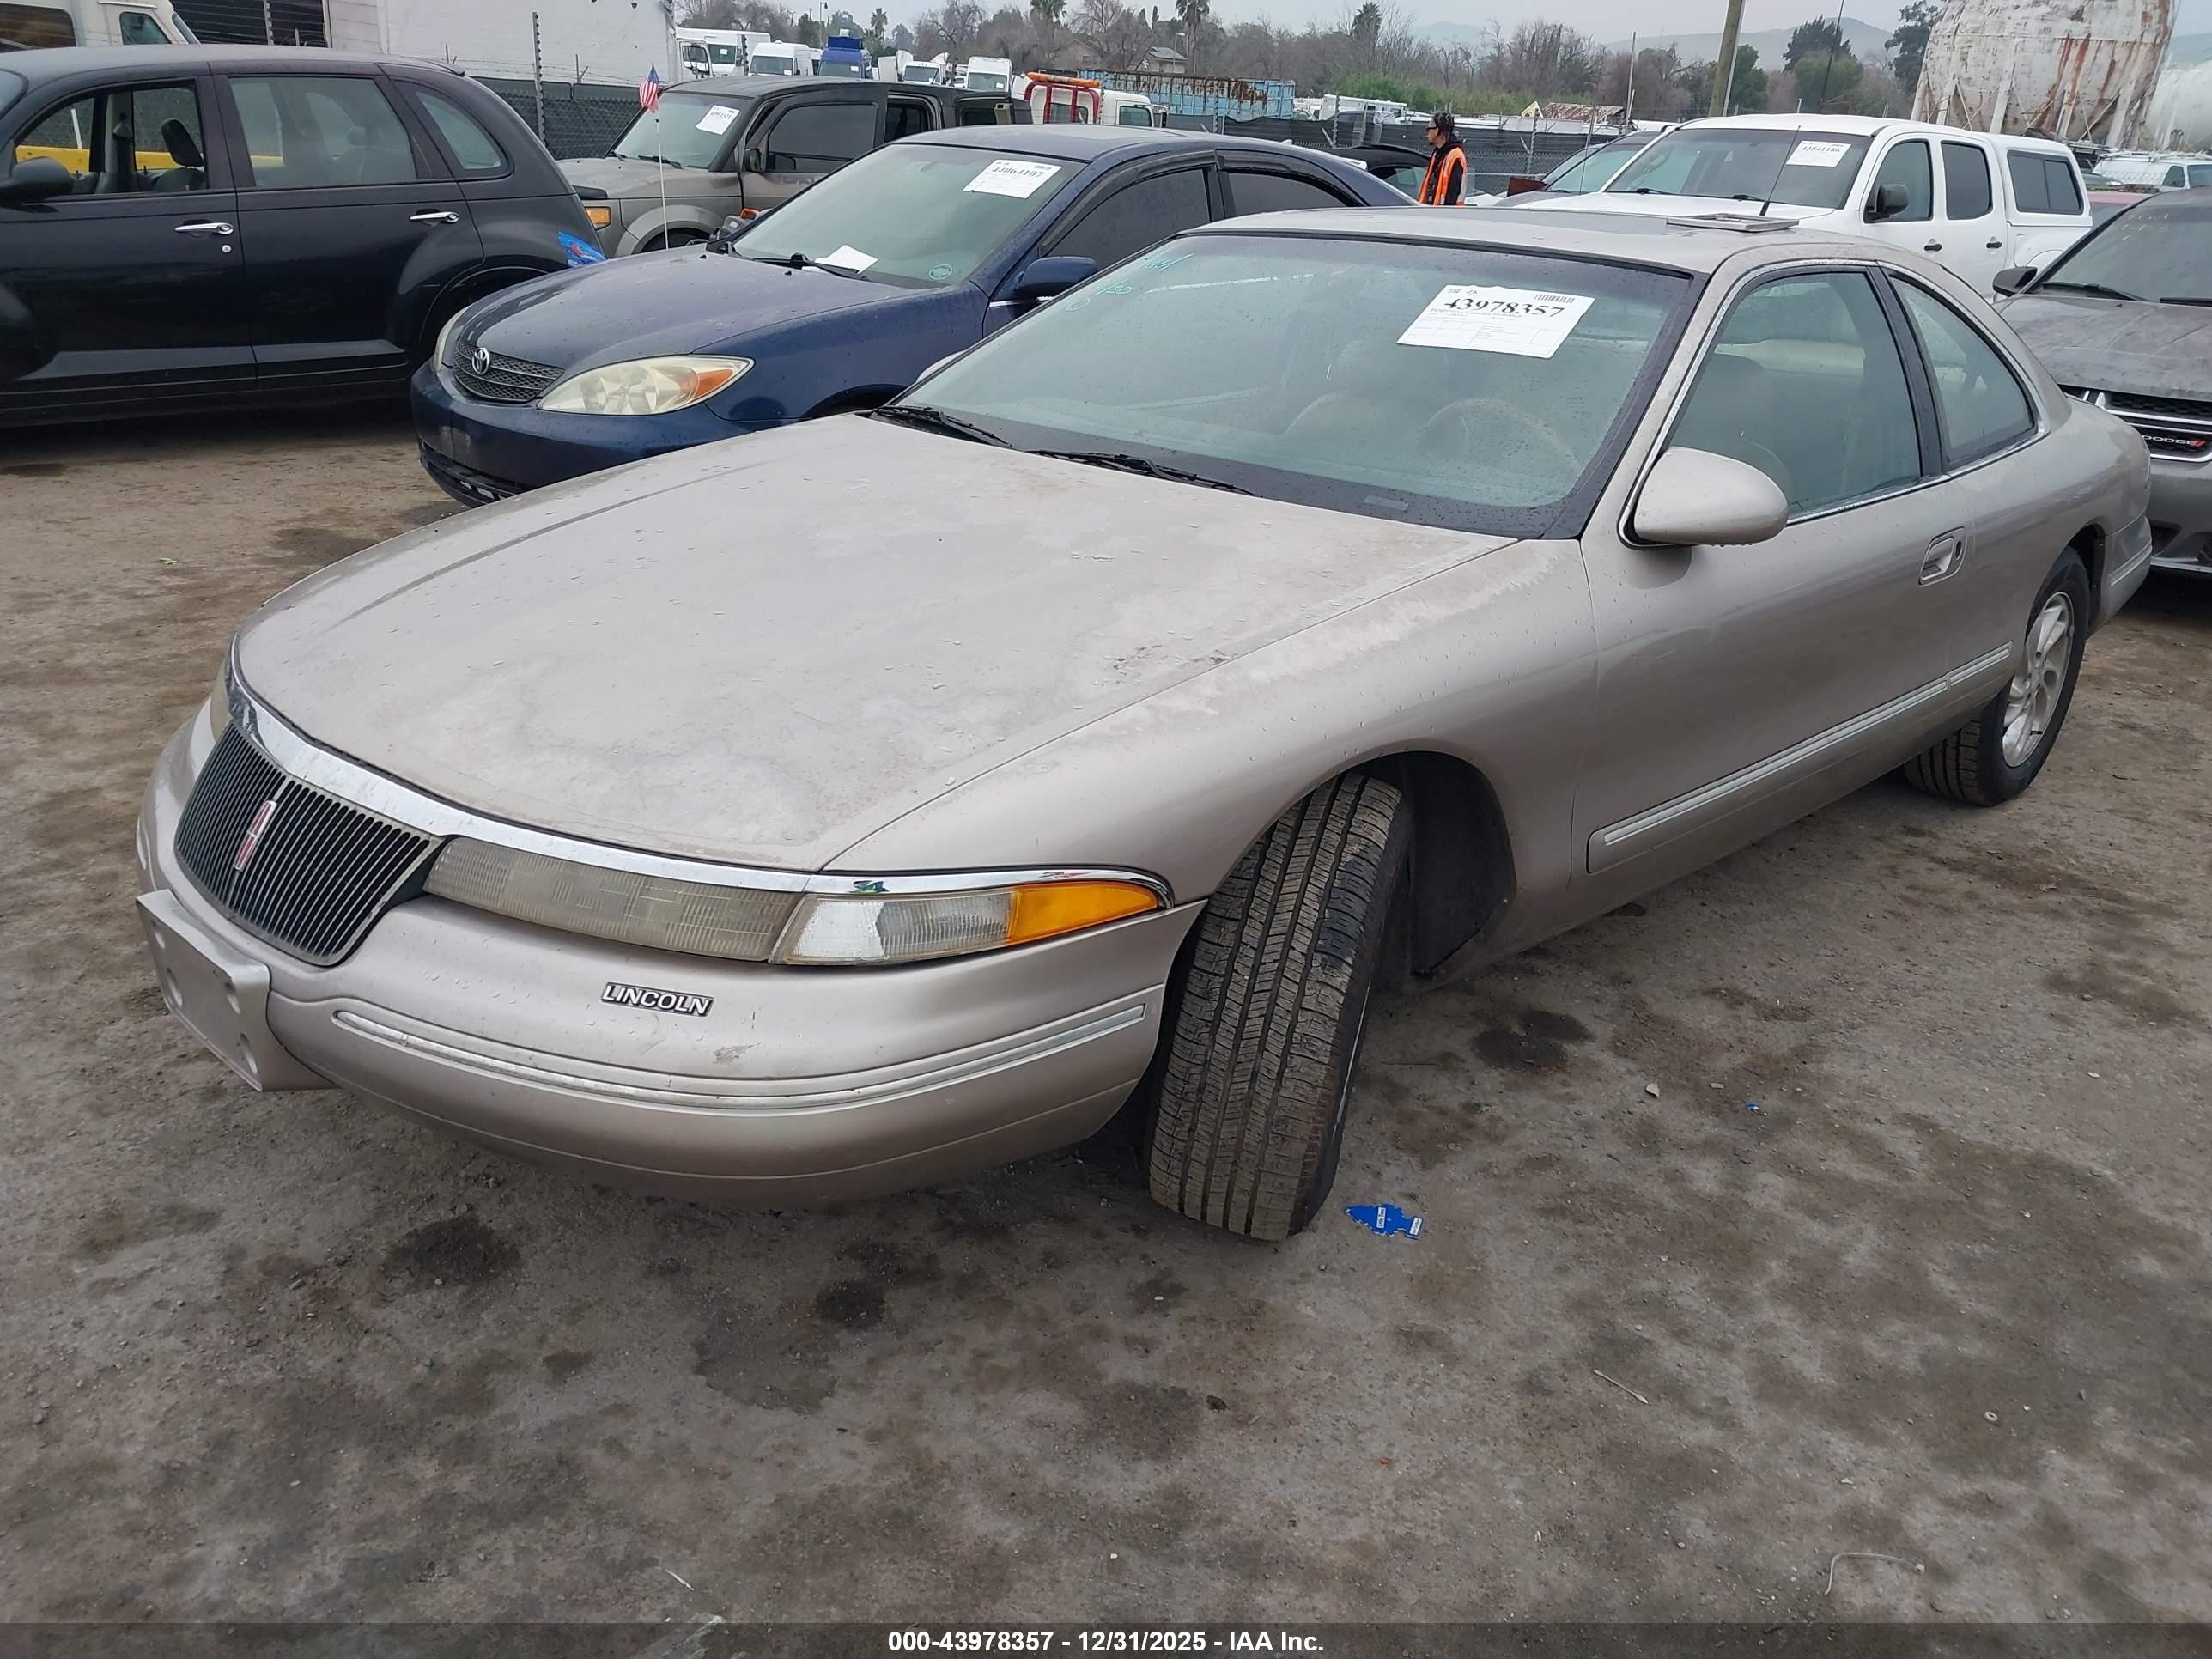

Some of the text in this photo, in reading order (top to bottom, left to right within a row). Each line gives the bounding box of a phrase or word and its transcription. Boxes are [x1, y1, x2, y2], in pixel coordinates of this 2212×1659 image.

[1444, 298, 1565, 318] 43978357
[2142, 434, 2197, 447] DODGE
[602, 985, 710, 1014] LINCOLN
